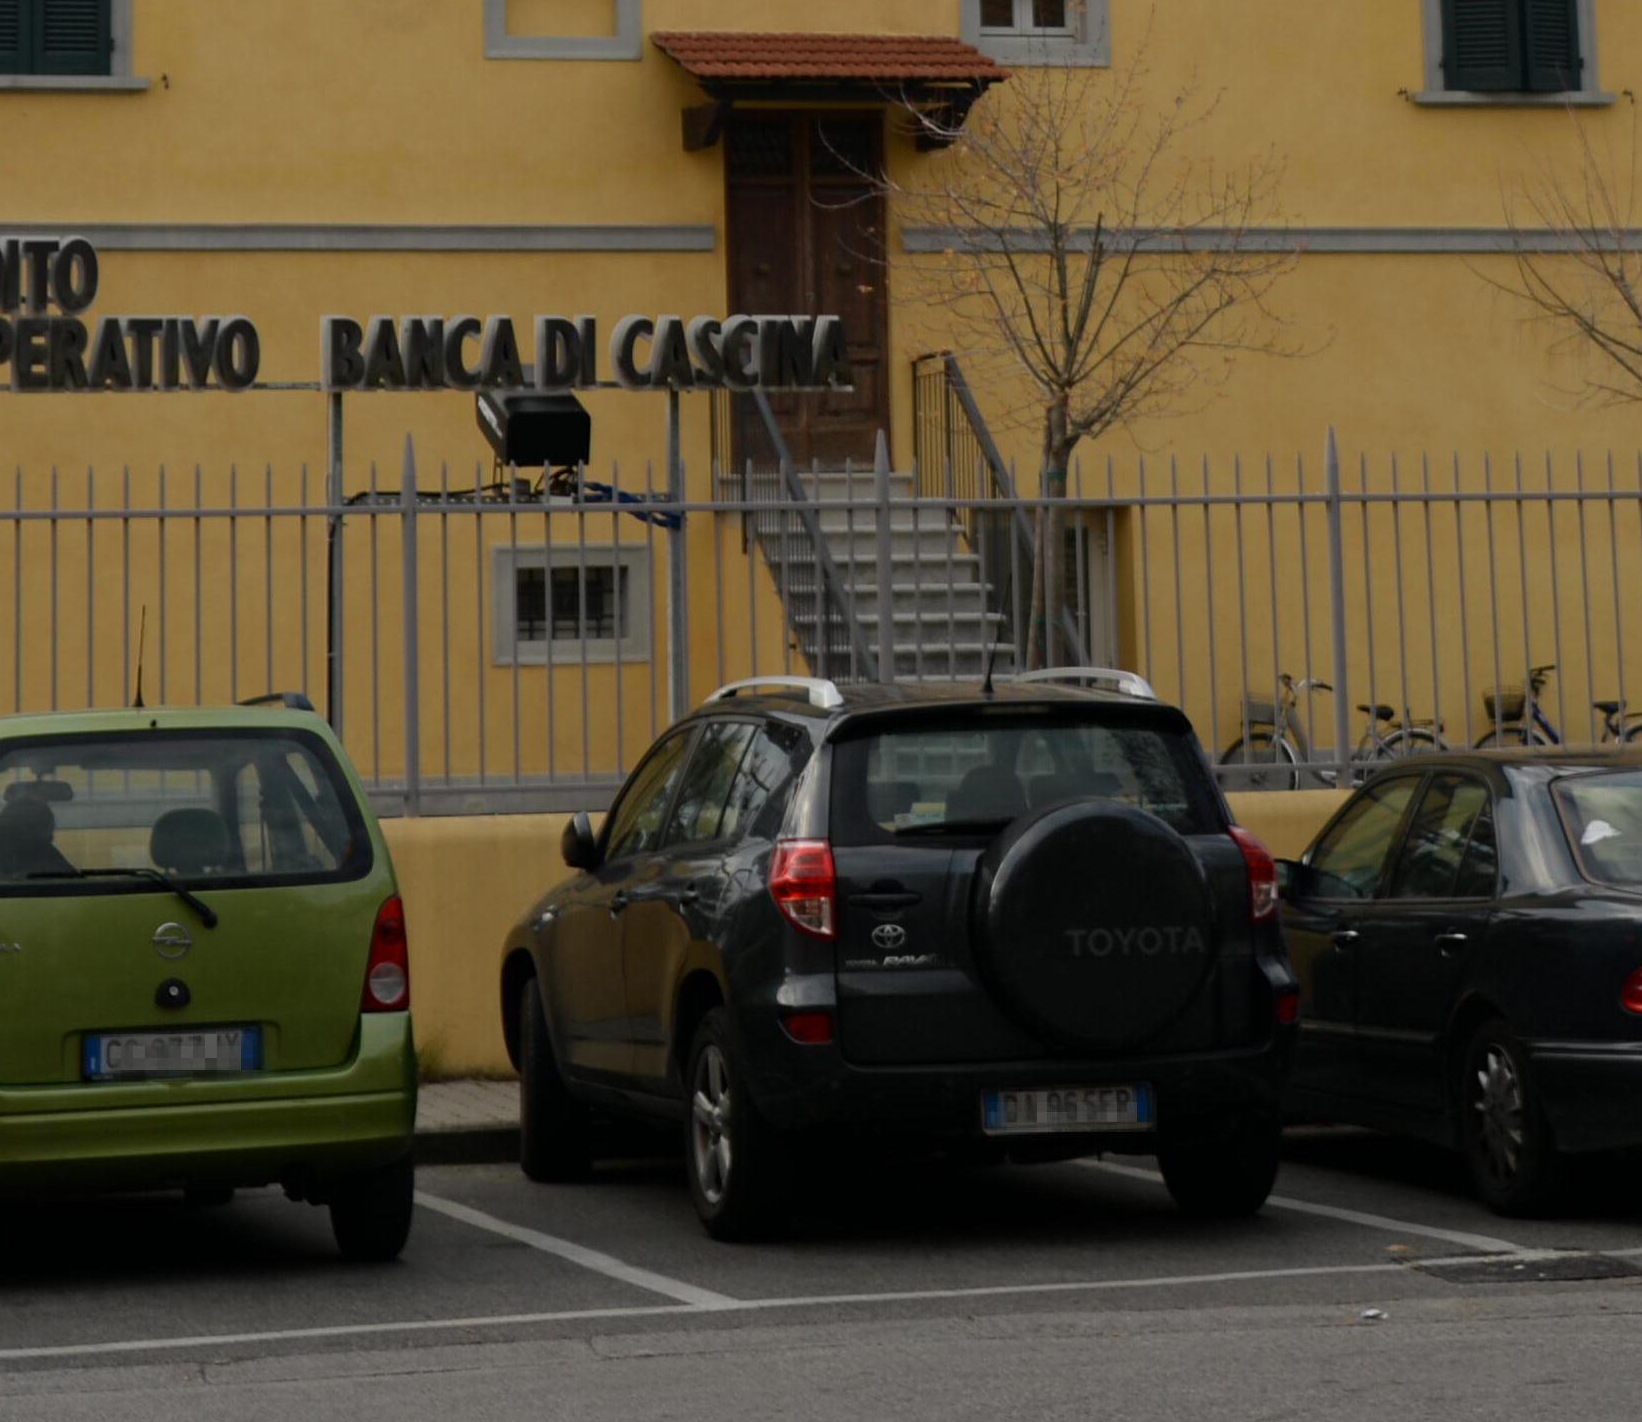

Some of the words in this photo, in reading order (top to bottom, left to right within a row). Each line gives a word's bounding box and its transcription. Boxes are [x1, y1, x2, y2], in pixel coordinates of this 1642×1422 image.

[320, 314, 523, 391] BANCA
[535, 314, 598, 391] DI
[611, 314, 855, 392] CASCINA
[1064, 926, 1206, 957] TOYOTA
